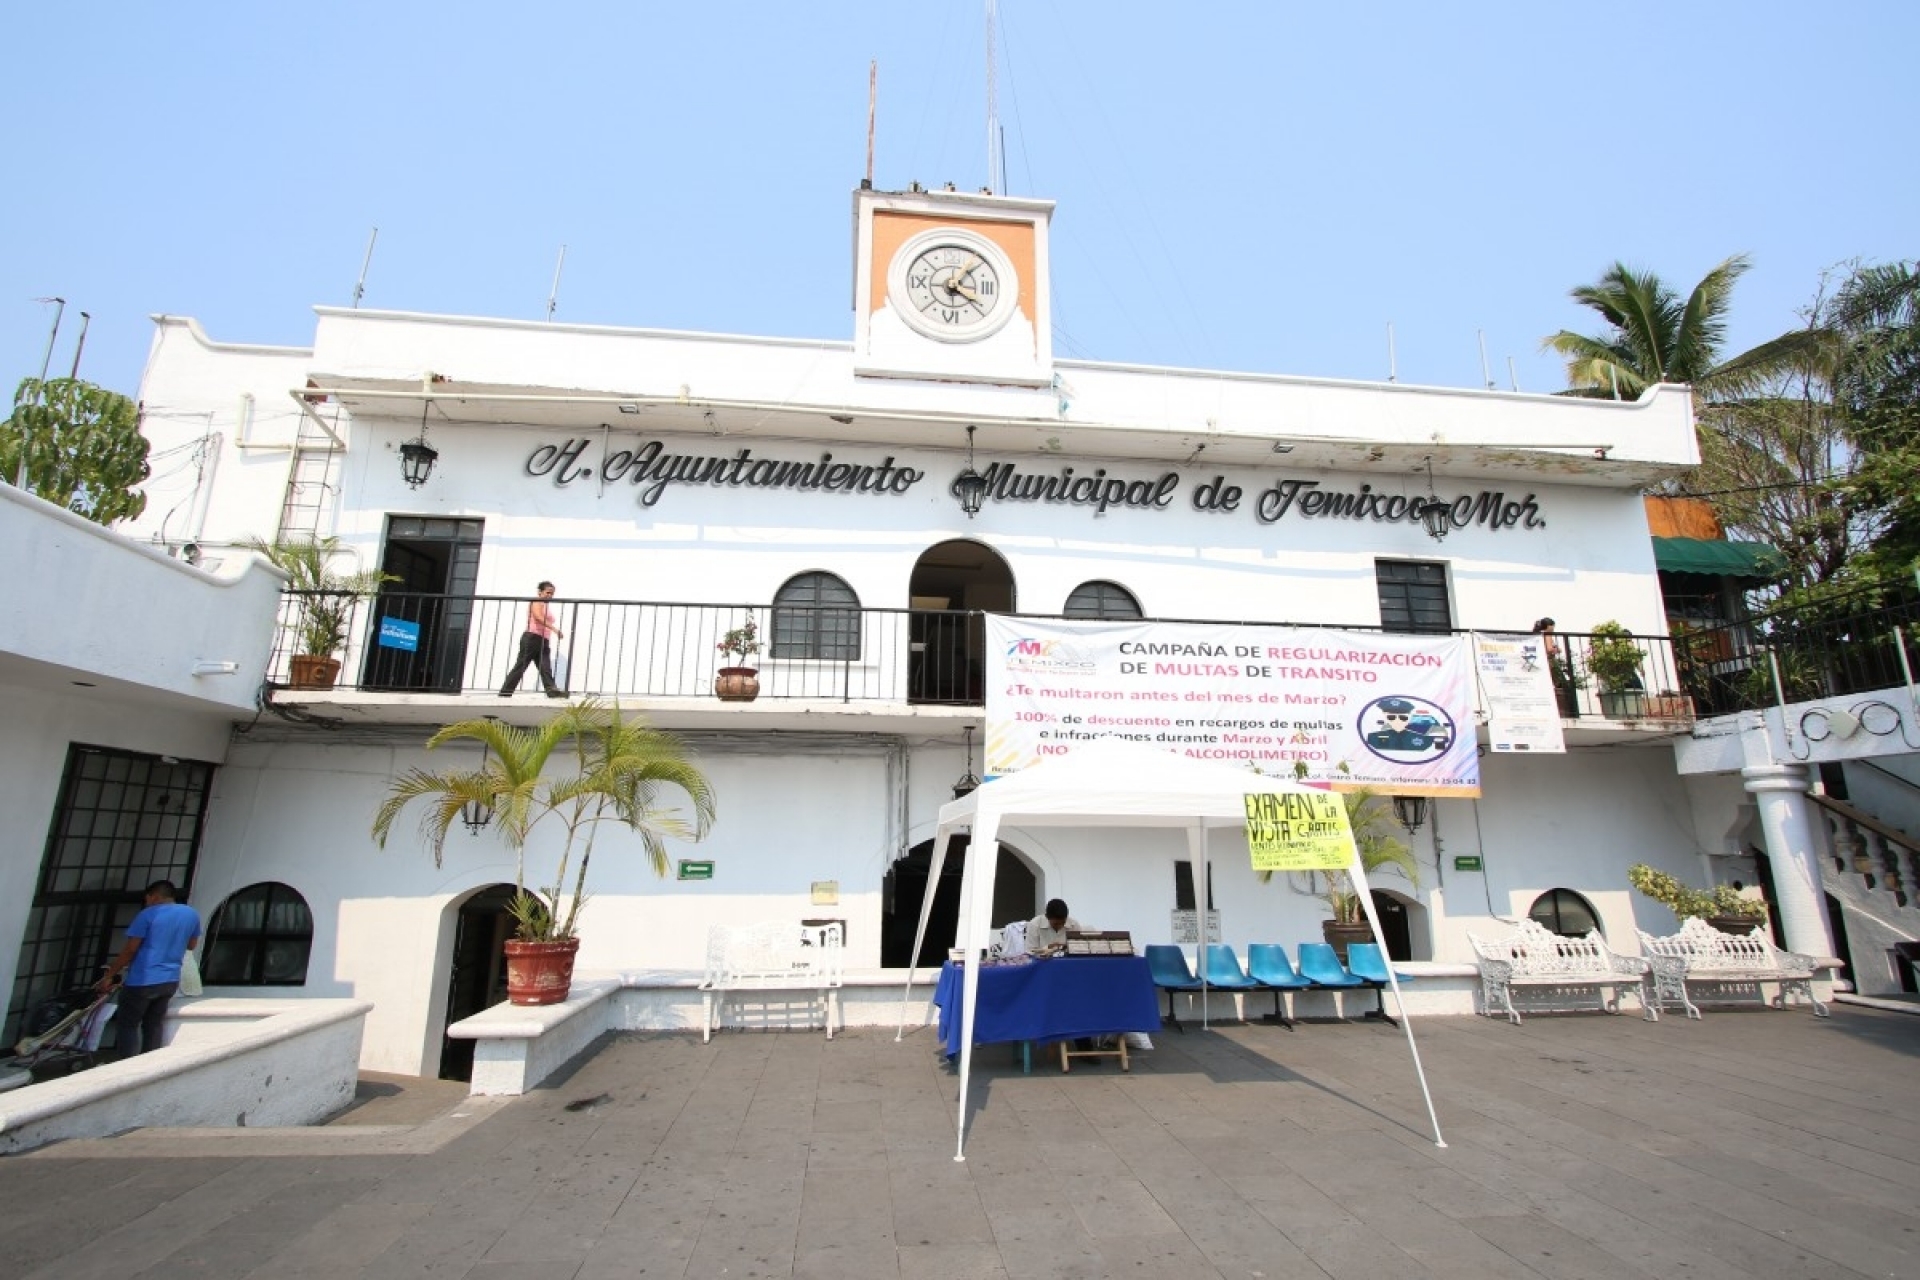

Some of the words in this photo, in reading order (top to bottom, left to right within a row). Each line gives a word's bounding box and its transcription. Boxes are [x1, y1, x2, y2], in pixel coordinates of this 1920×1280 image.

[526, 438, 593, 484] H.
[602, 440, 924, 507] Ayuntamiento
[951, 461, 1180, 513] Municipal
[1193, 475, 1243, 511] de
[1119, 641, 1228, 658] CAMPAÑA
[1235, 645, 1262, 658] DE
[1268, 647, 1443, 668] REGULARIZACIÓN
[1120, 661, 1148, 675] DE
[1154, 663, 1239, 677] MULTAS
[1246, 665, 1272, 678] DE
[1278, 666, 1378, 683] TRANSITO
[1040, 687, 1124, 700] multaron
[1130, 690, 1179, 702] antes
[1184, 690, 1212, 702] del
[1217, 694, 1256, 703] mes
[1258, 692, 1281, 704] de
[1284, 693, 1347, 706] Marzo?
[1014, 711, 1057, 723] 100%
[1062, 714, 1082, 725] de
[1087, 714, 1171, 727] descuento
[1176, 718, 1195, 728] en
[1200, 718, 1265, 730] recargos
[1270, 718, 1289, 729] de
[1293, 719, 1343, 731] multas
[1039, 730, 1049, 738] e
[1156, 732, 1218, 744] durante
[1223, 733, 1273, 745] Marzo
[1277, 737, 1285, 747] y
[1289, 733, 1328, 746] Abril
[1036, 743, 1069, 756] (NO
[1184, 748, 1329, 762] ALCOHOLIMETRO)
[1244, 793, 1316, 820] EXAMEN
[1247, 820, 1291, 842] VISTA
